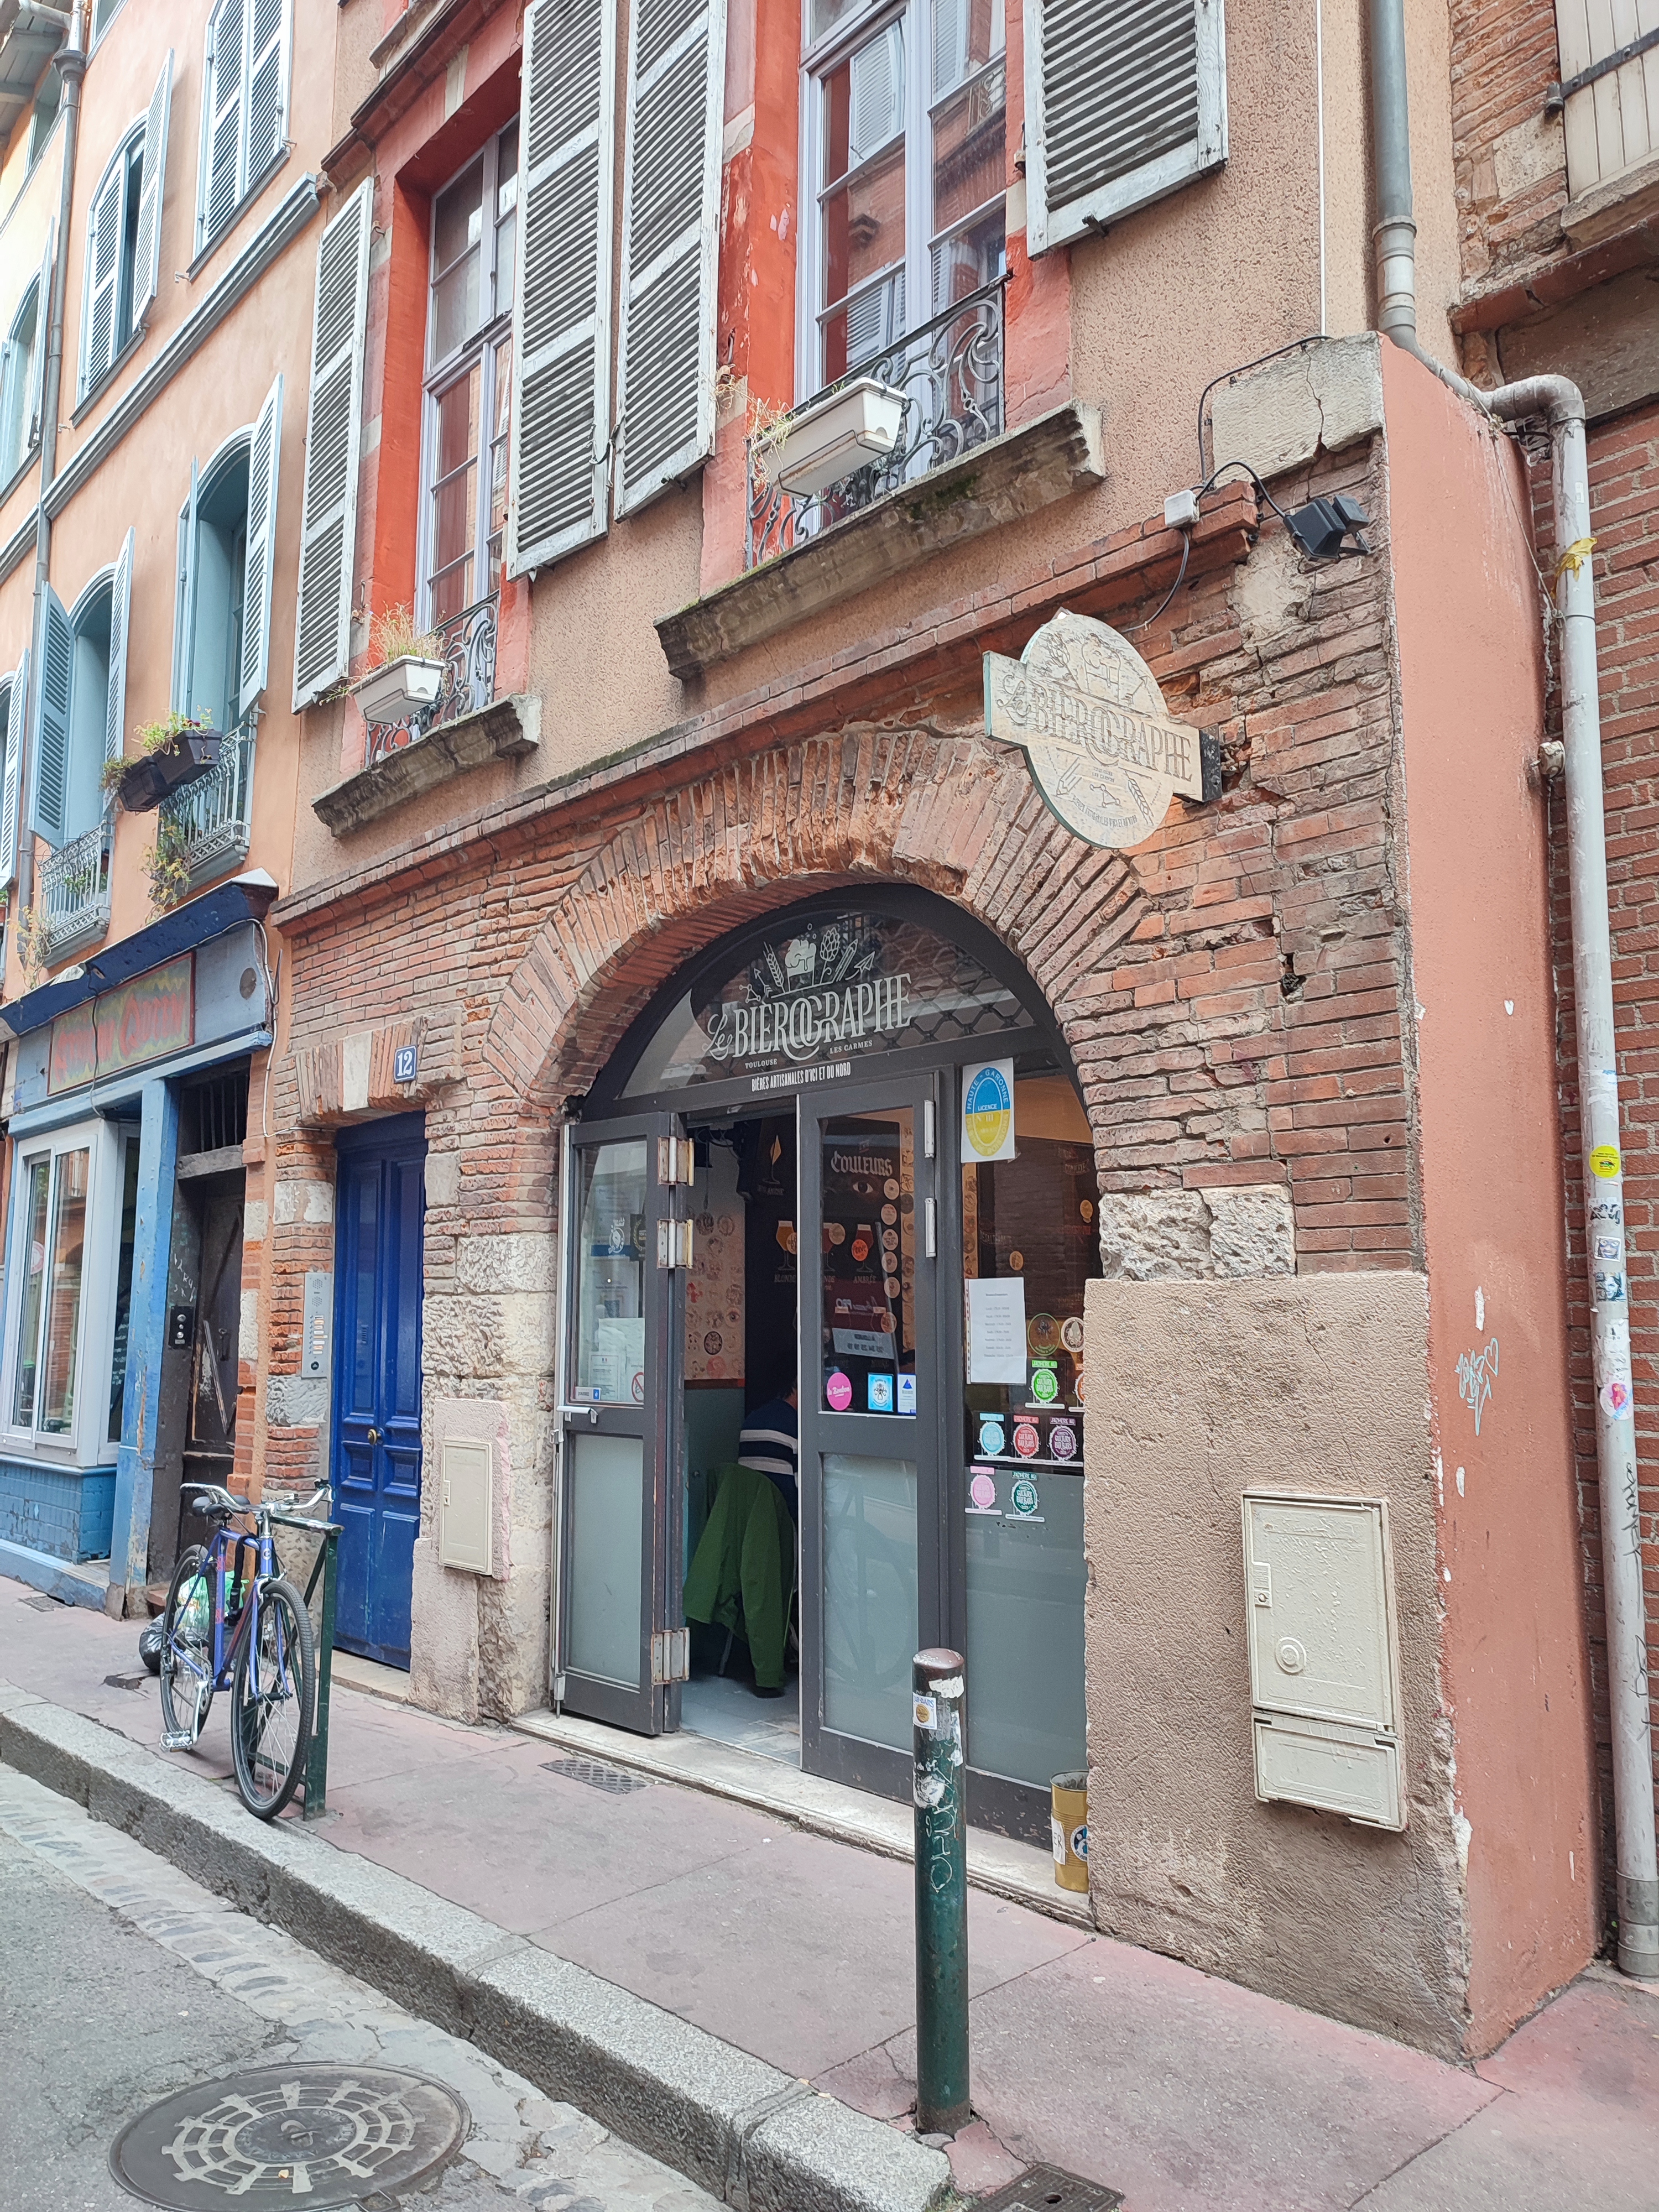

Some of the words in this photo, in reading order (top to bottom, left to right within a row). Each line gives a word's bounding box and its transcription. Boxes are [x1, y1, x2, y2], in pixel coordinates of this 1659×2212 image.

[702, 1014, 733, 1061] Le
[830, 1046, 842, 1055] LES
[844, 1040, 873, 1051] CARMES
[397, 1051, 413, 1077] 12
[745, 1058, 778, 1070] TOULOUSE
[752, 1076, 769, 1092] BIÈRES
[770, 1070, 804, 1089] ARTISANALES
[805, 1068, 818, 1083] D'ICI
[818, 1066, 826, 1081] ET
[826, 1064, 834, 1079] DU
[836, 1062, 851, 1078] NORD
[967, 1080, 979, 1109] HAUTE
[985, 1069, 1009, 1104] GARONNE
[978, 1103, 997, 1112] LICENCE
[831, 1150, 893, 1177] COULEURS
